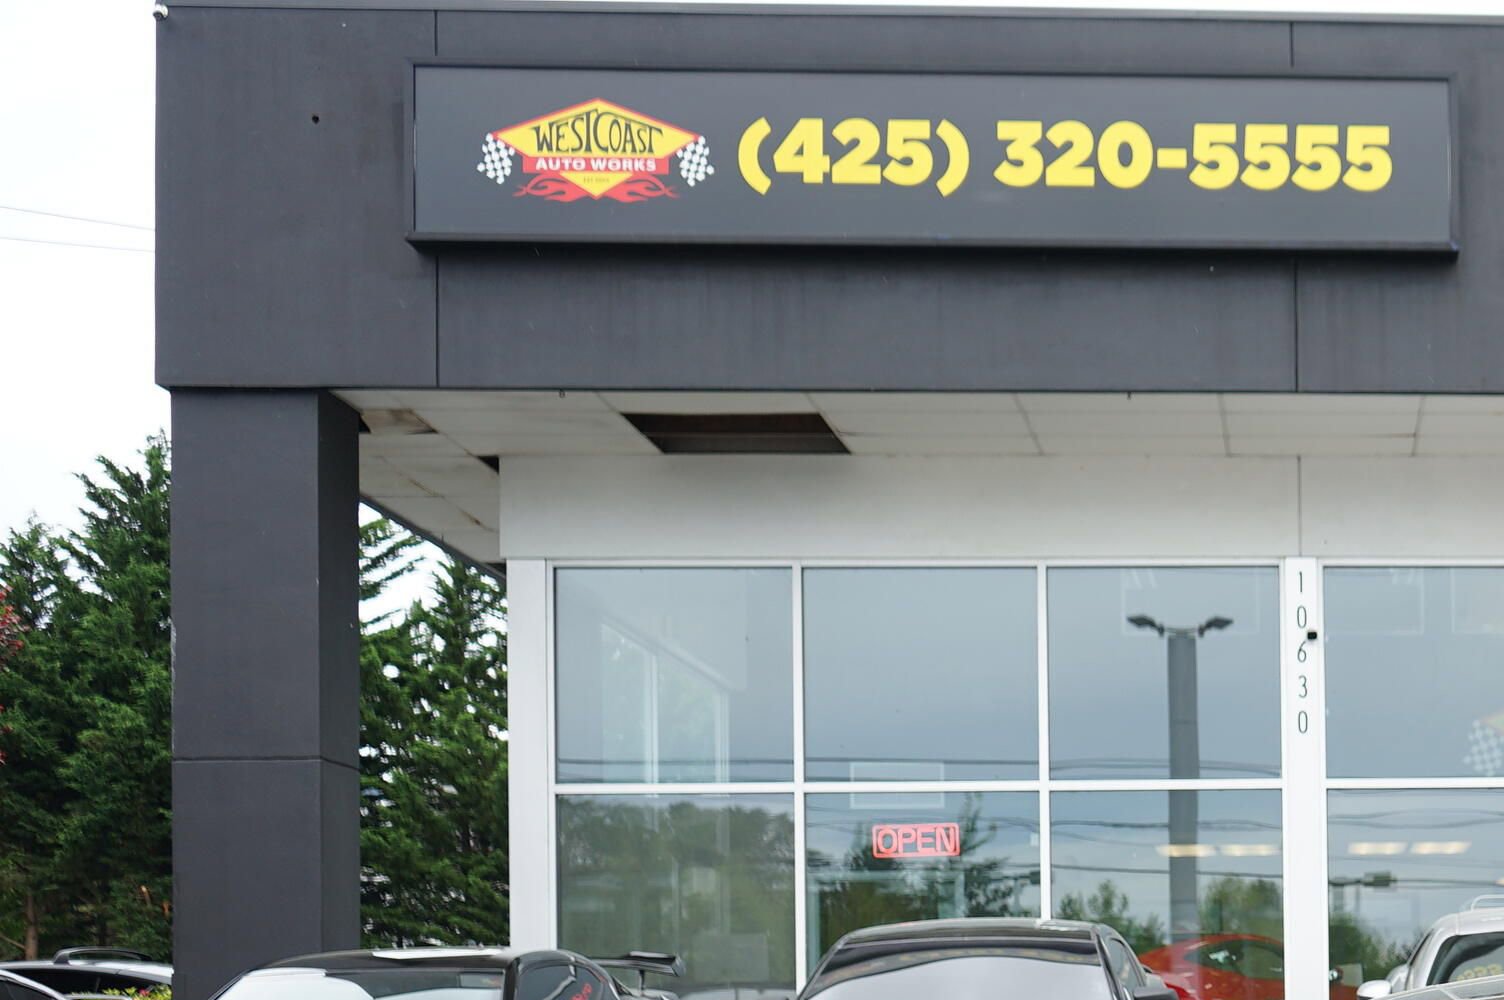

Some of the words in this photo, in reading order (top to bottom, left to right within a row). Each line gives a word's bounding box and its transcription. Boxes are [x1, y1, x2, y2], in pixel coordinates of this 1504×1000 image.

[536, 157, 586, 172] AUTO
[591, 158, 657, 173] WORKS
[737, 118, 970, 197] (425)
[993, 119, 1393, 192] 320-5555
[877, 827, 955, 854] OPEN
